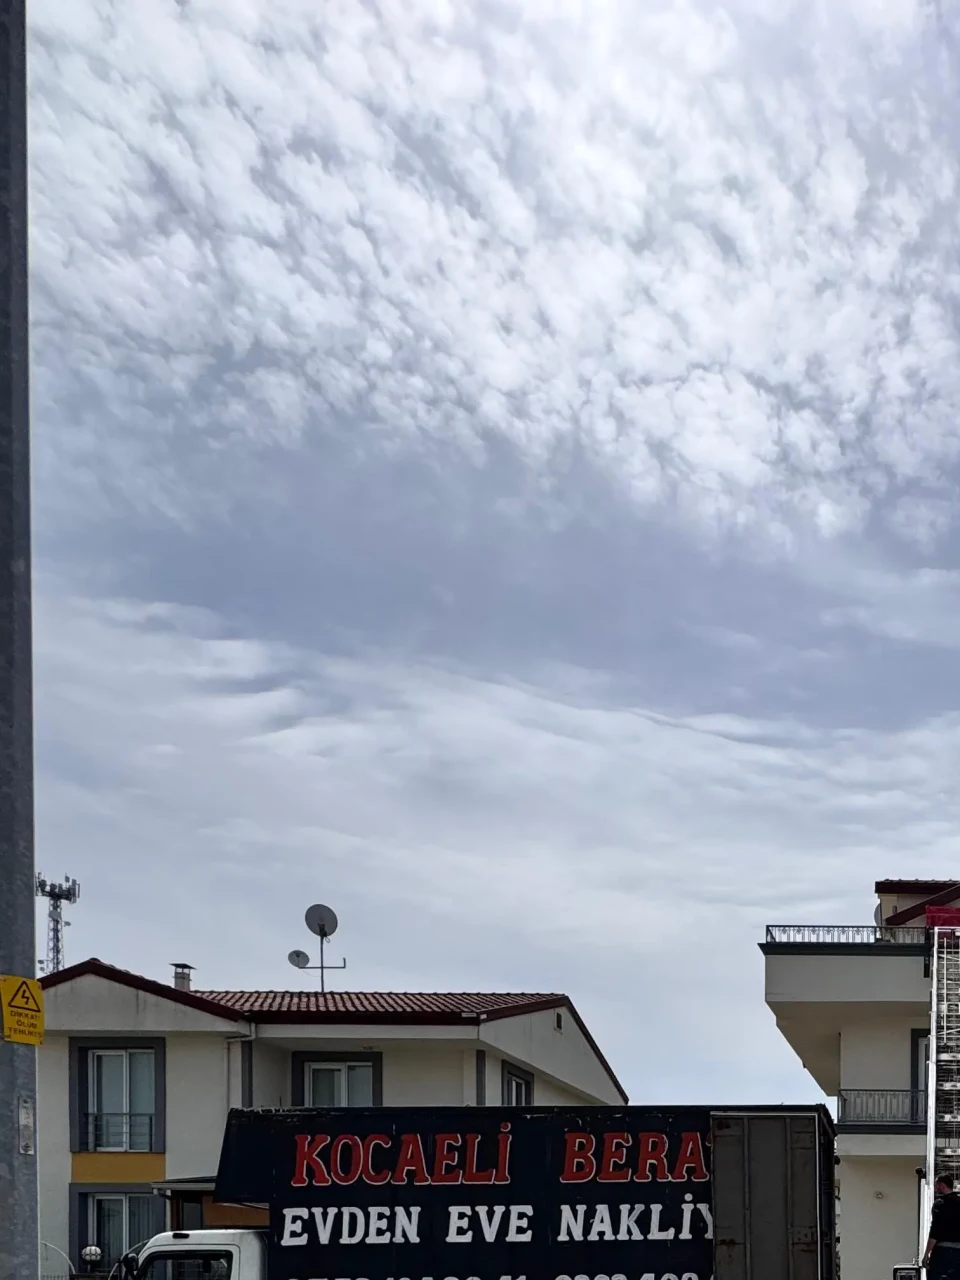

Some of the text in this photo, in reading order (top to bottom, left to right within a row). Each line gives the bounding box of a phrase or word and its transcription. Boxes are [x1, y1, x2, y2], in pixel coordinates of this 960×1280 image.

[291, 1122, 712, 1186] KOCAELİ BERA
[281, 1206, 421, 1246] EVDEN
[445, 1205, 533, 1243] EVE
